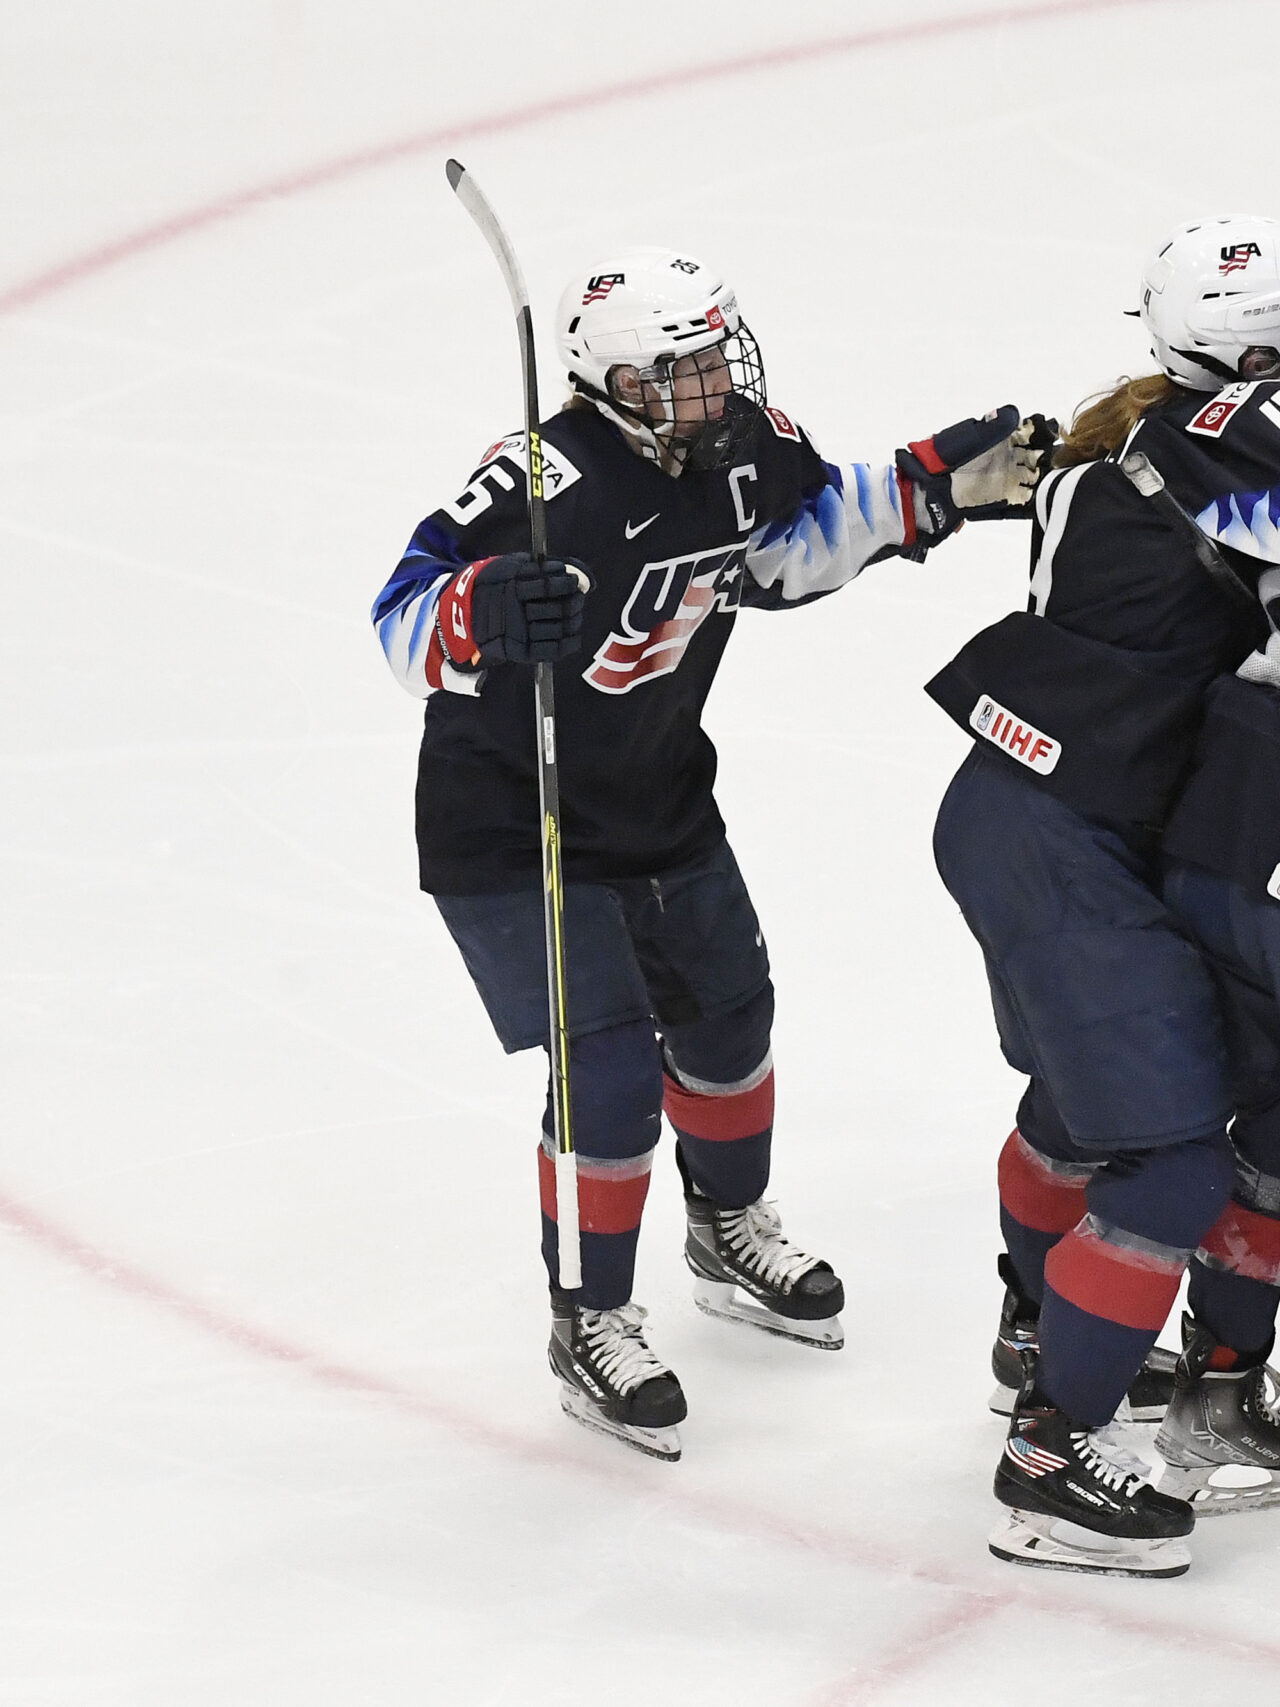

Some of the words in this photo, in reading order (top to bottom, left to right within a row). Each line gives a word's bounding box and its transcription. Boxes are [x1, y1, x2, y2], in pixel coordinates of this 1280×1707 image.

[670, 258, 701, 275] 26
[1218, 242, 1262, 278] USA
[583, 273, 626, 306] USA
[529, 431, 543, 498] CCM
[728, 463, 758, 532] C
[582, 542, 751, 695] USA
[991, 711, 1054, 763] IIHF
[572, 1362, 606, 1399] CCM
